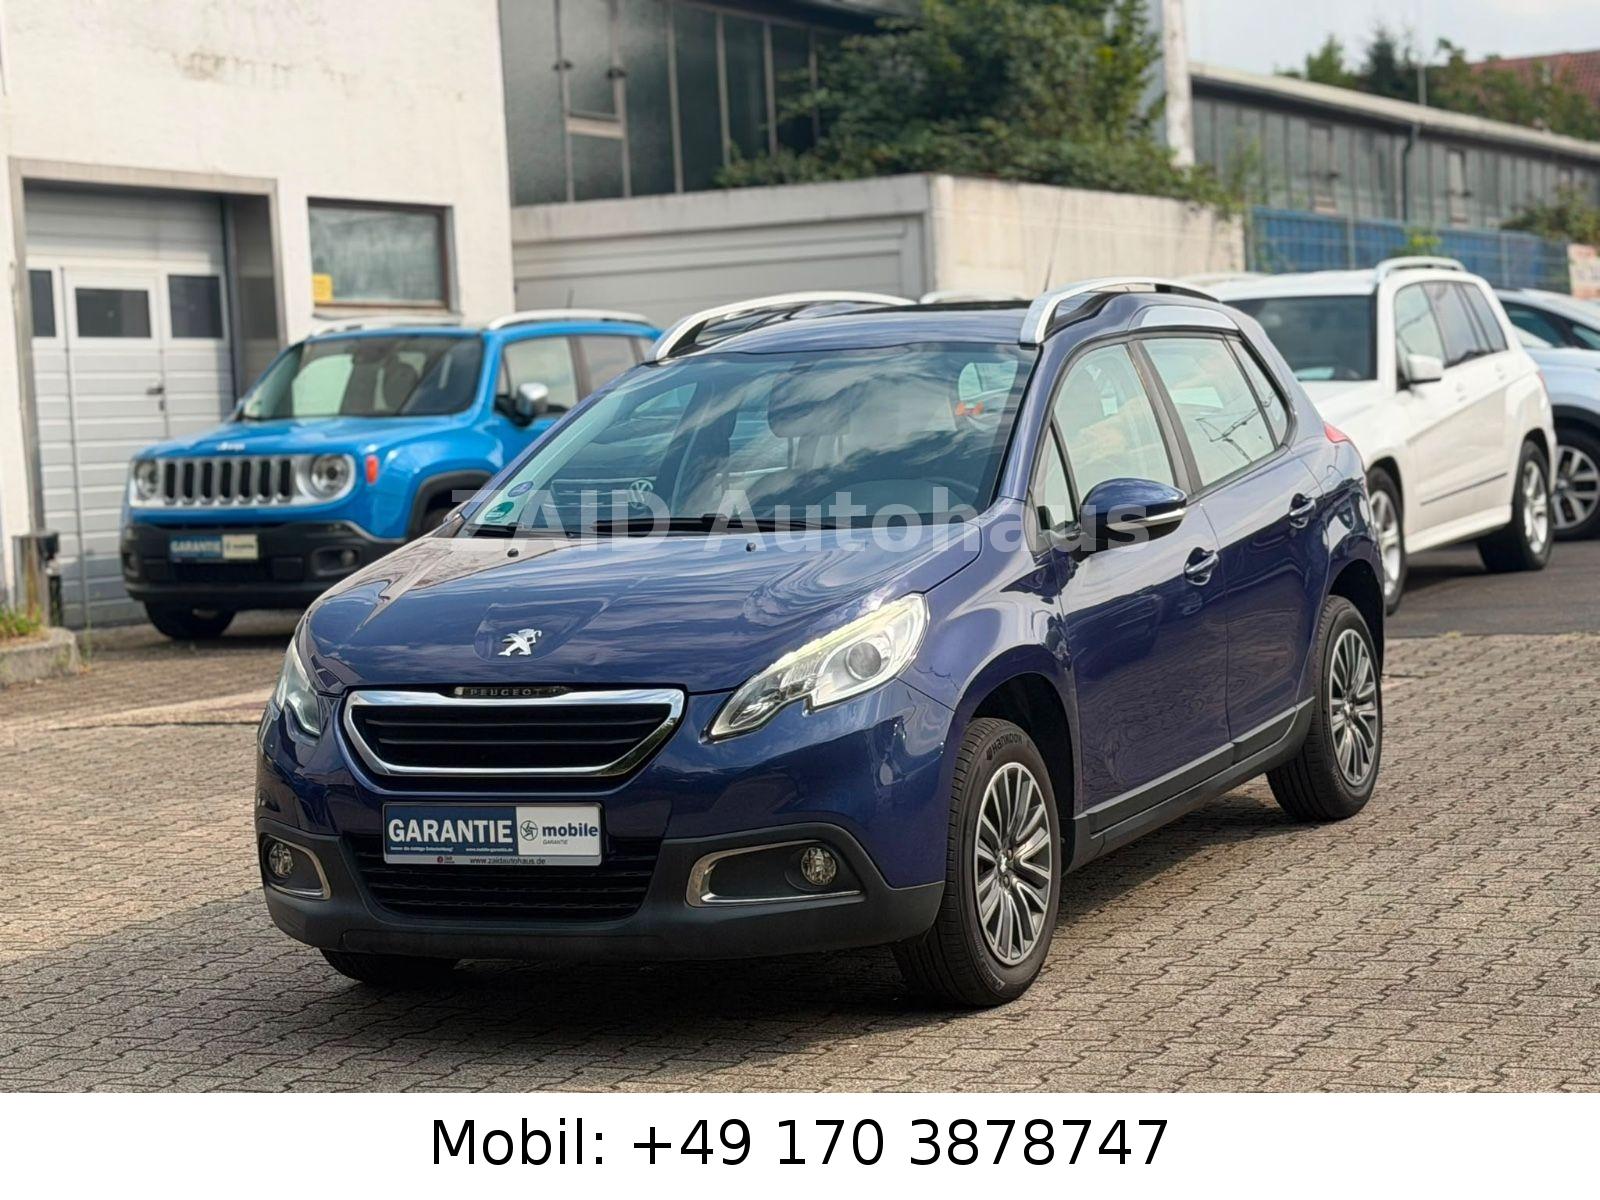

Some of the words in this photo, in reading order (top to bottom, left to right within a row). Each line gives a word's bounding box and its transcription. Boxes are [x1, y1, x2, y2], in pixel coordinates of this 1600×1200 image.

[470, 687, 543, 697] PEUGEOT
[388, 818, 514, 844] GARANTIE
[542, 822, 599, 838] mobile
